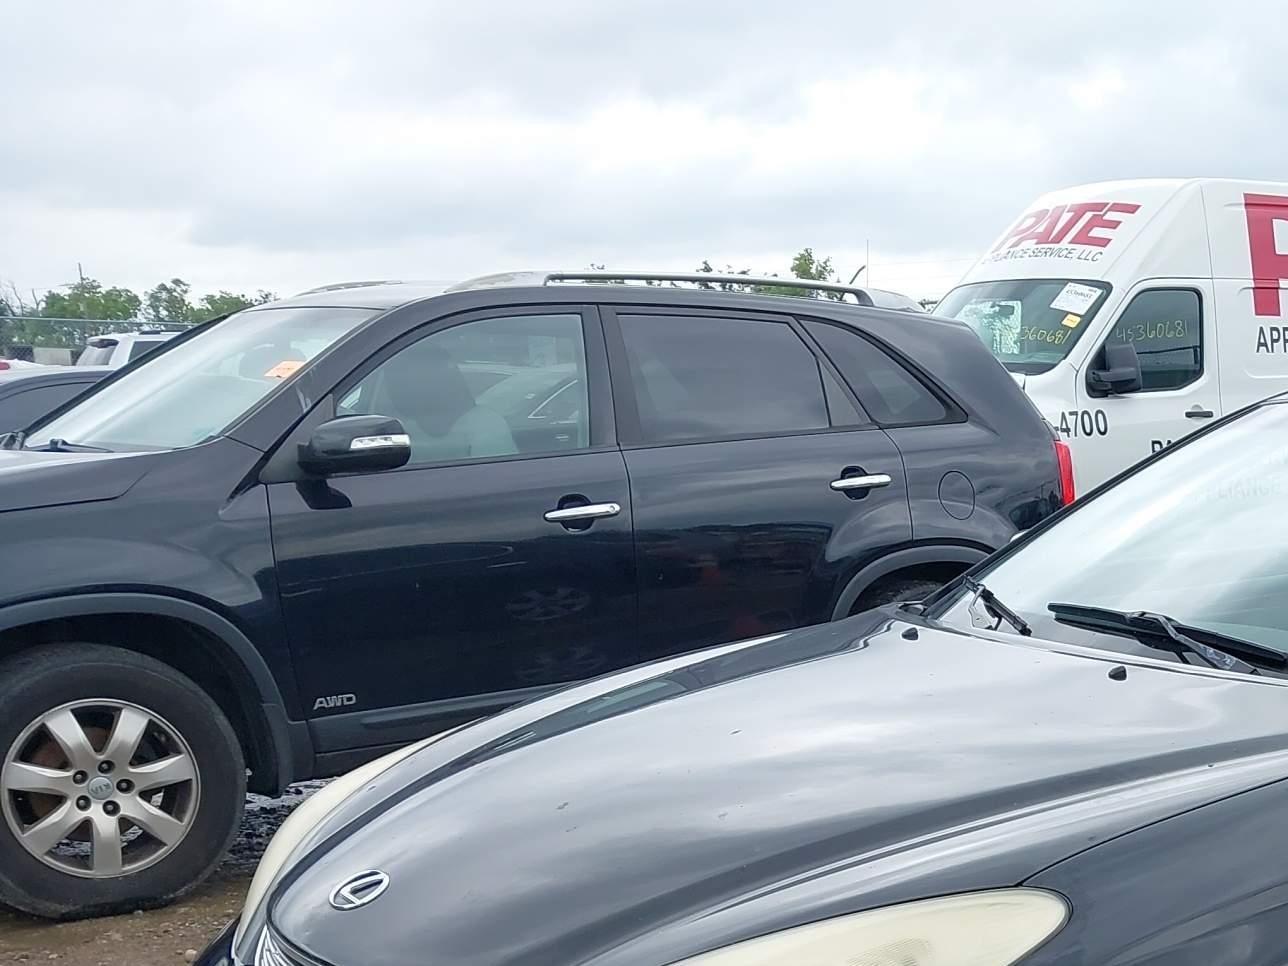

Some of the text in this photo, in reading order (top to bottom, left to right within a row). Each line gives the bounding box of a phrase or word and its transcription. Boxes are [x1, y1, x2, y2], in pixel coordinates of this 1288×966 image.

[992, 202, 1142, 252] PATE
[1028, 247, 1076, 259] SERVICE,
[1076, 248, 1103, 262] LLC
[1116, 320, 1188, 343] 45360681
[313, 694, 356, 710] AWD
